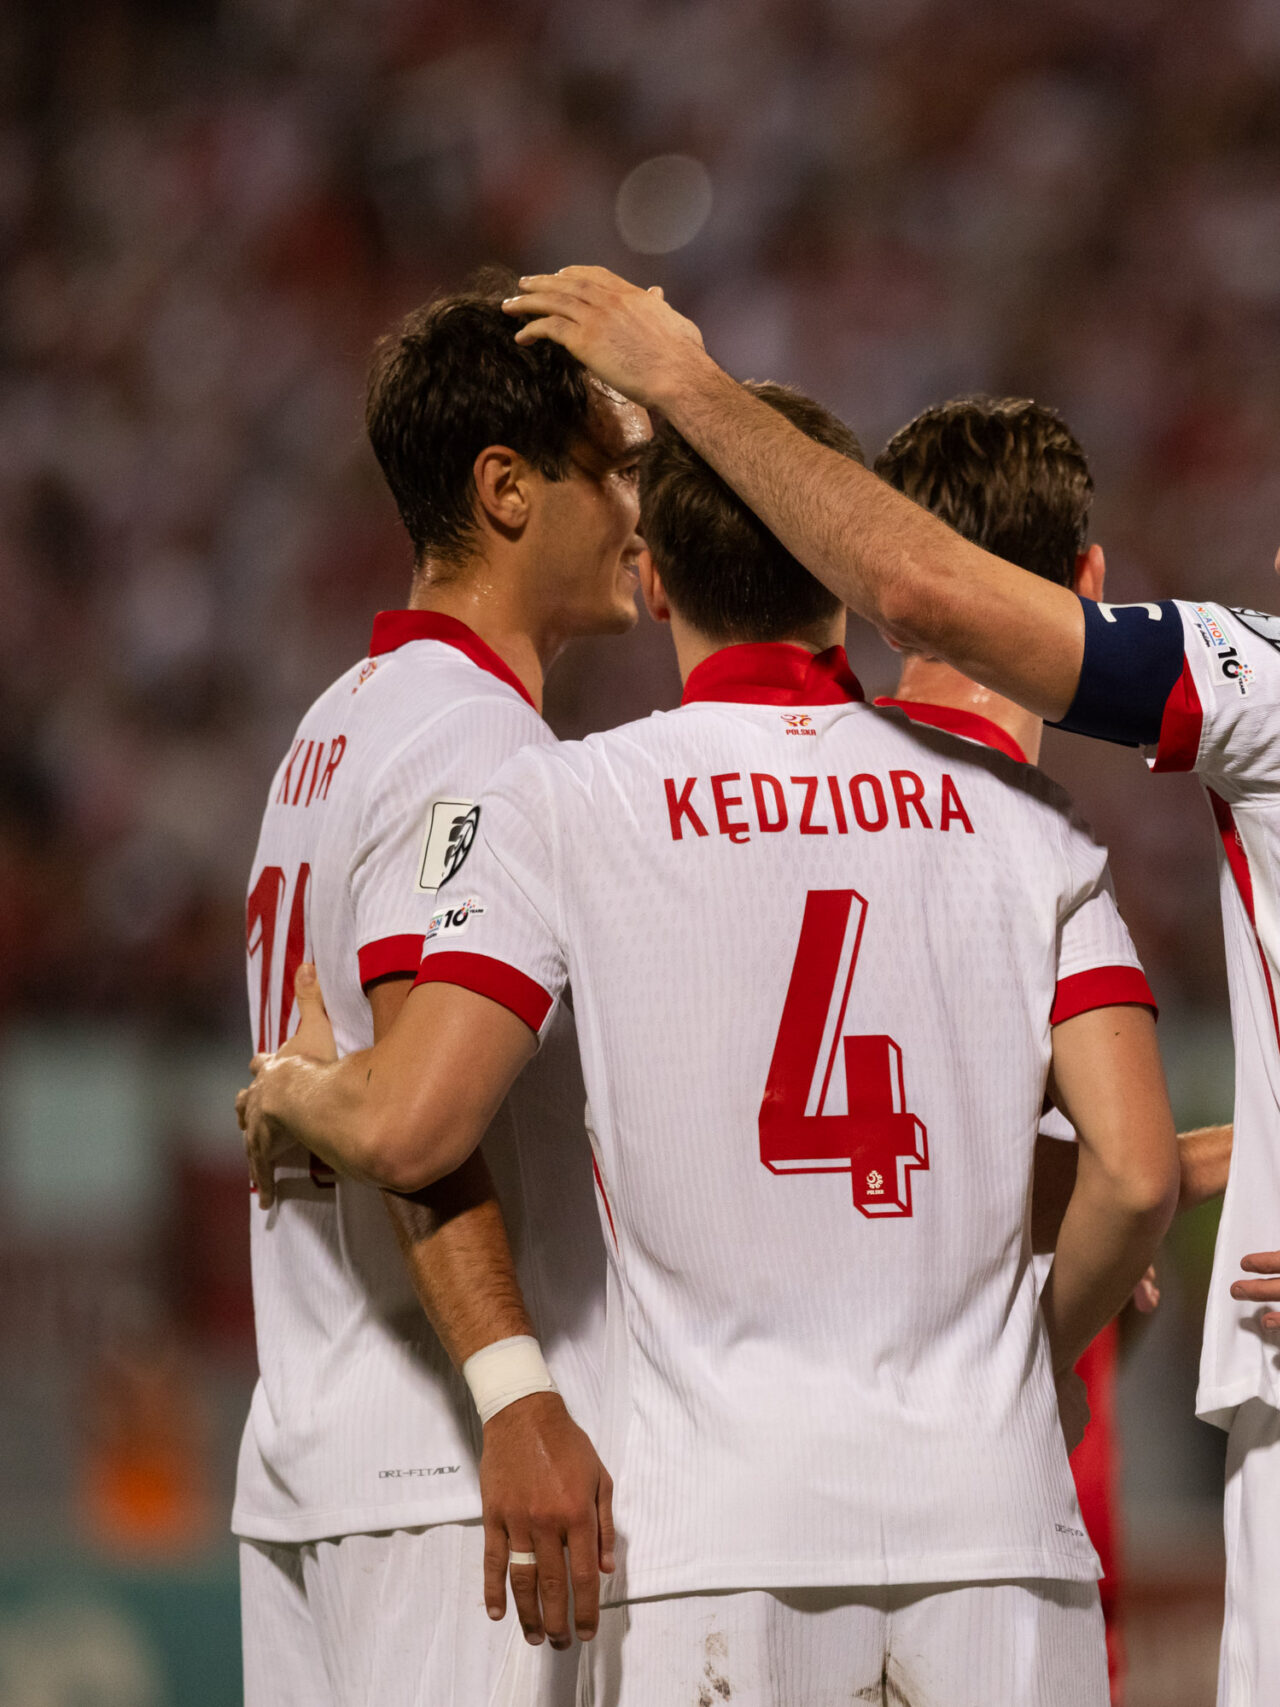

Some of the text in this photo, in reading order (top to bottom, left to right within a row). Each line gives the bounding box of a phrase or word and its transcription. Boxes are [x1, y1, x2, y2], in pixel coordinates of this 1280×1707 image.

[1218, 646, 1242, 679] 10
[785, 728, 817, 736] POLSKA
[663, 769, 975, 844] KĘDZIORA
[444, 908, 469, 929] 10
[758, 889, 930, 1219] 4
